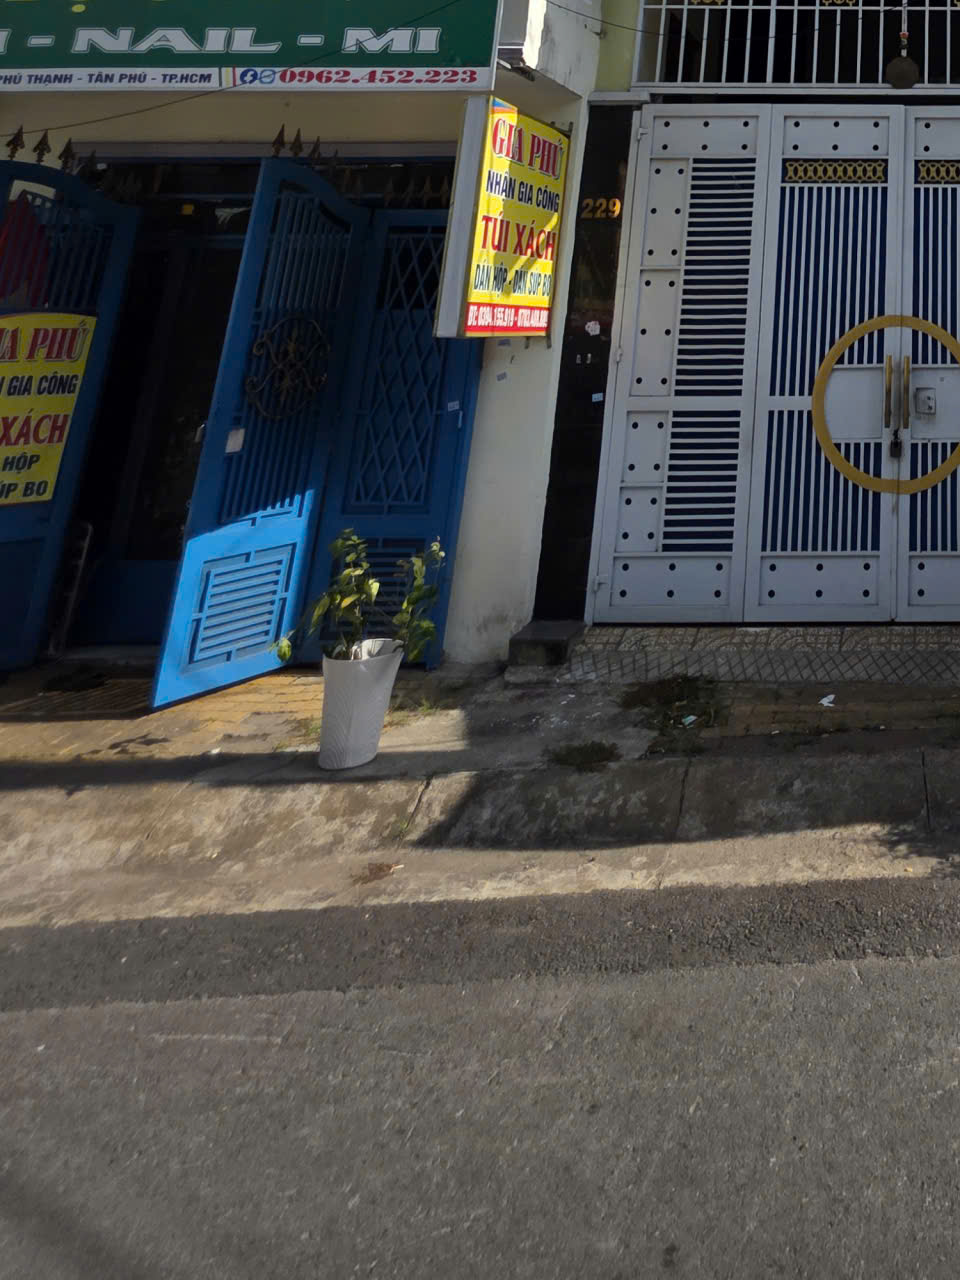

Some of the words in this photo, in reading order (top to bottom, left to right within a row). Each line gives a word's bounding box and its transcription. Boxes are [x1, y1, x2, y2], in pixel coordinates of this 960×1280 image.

[71, 27, 281, 54] NAIL
[341, 26, 442, 54] MI
[27, 73, 73, 87] THẠNH
[87, 70, 115, 84] TÂN
[161, 72, 213, 84] TP.HCM
[279, 68, 478, 85] 0962.452.223
[491, 118, 525, 164] GIA
[528, 133, 565, 179] PHÚ
[486, 170, 517, 203] NHẬN
[518, 181, 534, 206] GIA
[536, 184, 560, 213] CÔNG
[582, 198, 621, 218] 229
[481, 211, 510, 252] TÚI
[514, 219, 557, 261] XÁCH
[25, 319, 90, 362] PHÚ
[7, 375, 34, 396] GIA
[37, 371, 79, 396] CÔNG
[0, 408, 71, 447] XÁCH
[2, 452, 41, 474] HỘP
[22, 480, 49, 497] BO
